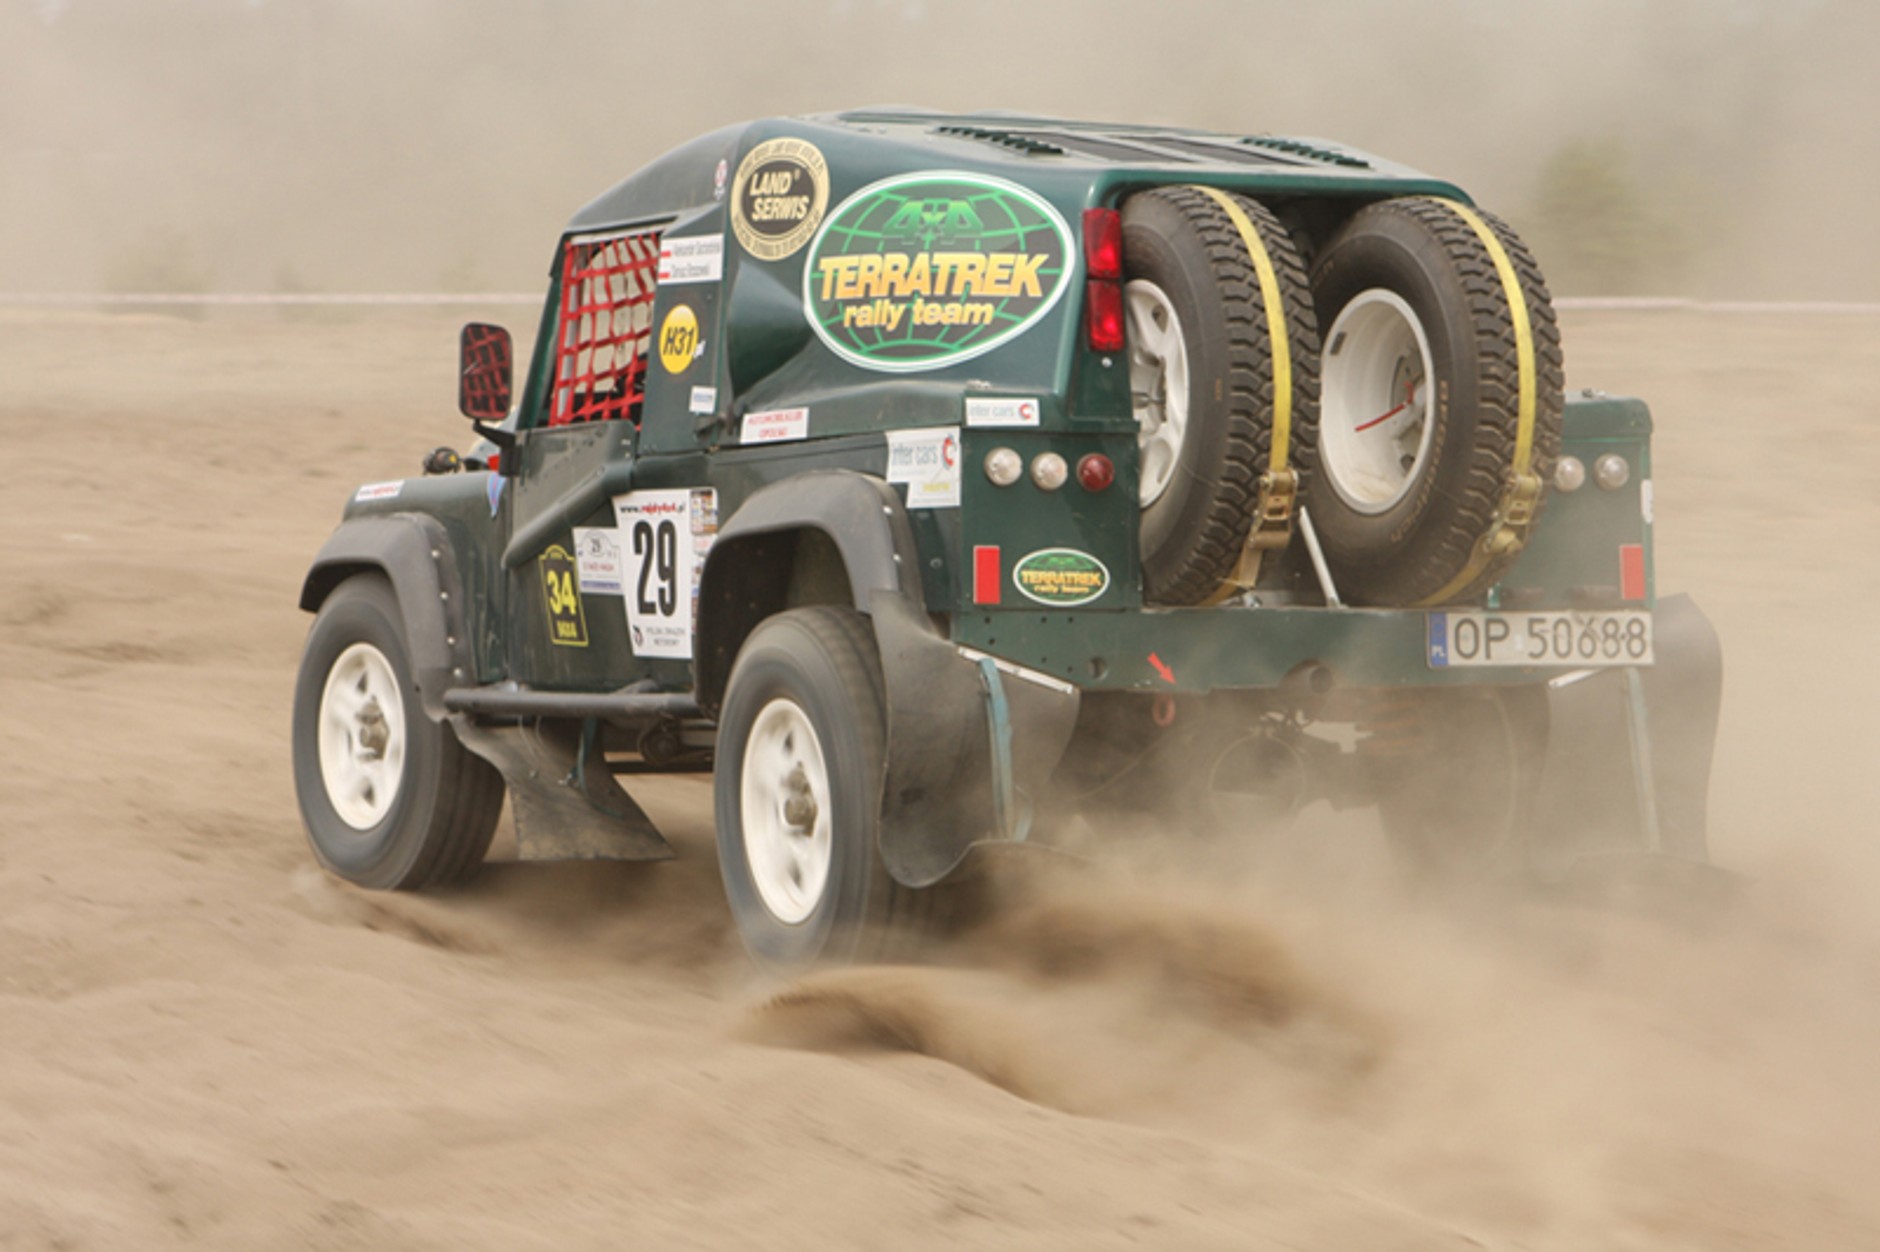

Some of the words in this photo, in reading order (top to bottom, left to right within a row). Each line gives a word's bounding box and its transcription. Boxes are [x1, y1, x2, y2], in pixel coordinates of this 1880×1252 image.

[749, 171, 792, 196] LAND
[819, 252, 1049, 301] TERRATREK
[843, 299, 905, 332] rally
[912, 298, 994, 326] team
[662, 326, 695, 356] H31
[633, 519, 677, 617] 29
[1021, 571, 1102, 585] TERRATREK
[546, 570, 577, 615] 34
[1454, 618, 1510, 660] OP
[1527, 618, 1647, 659] 50688
